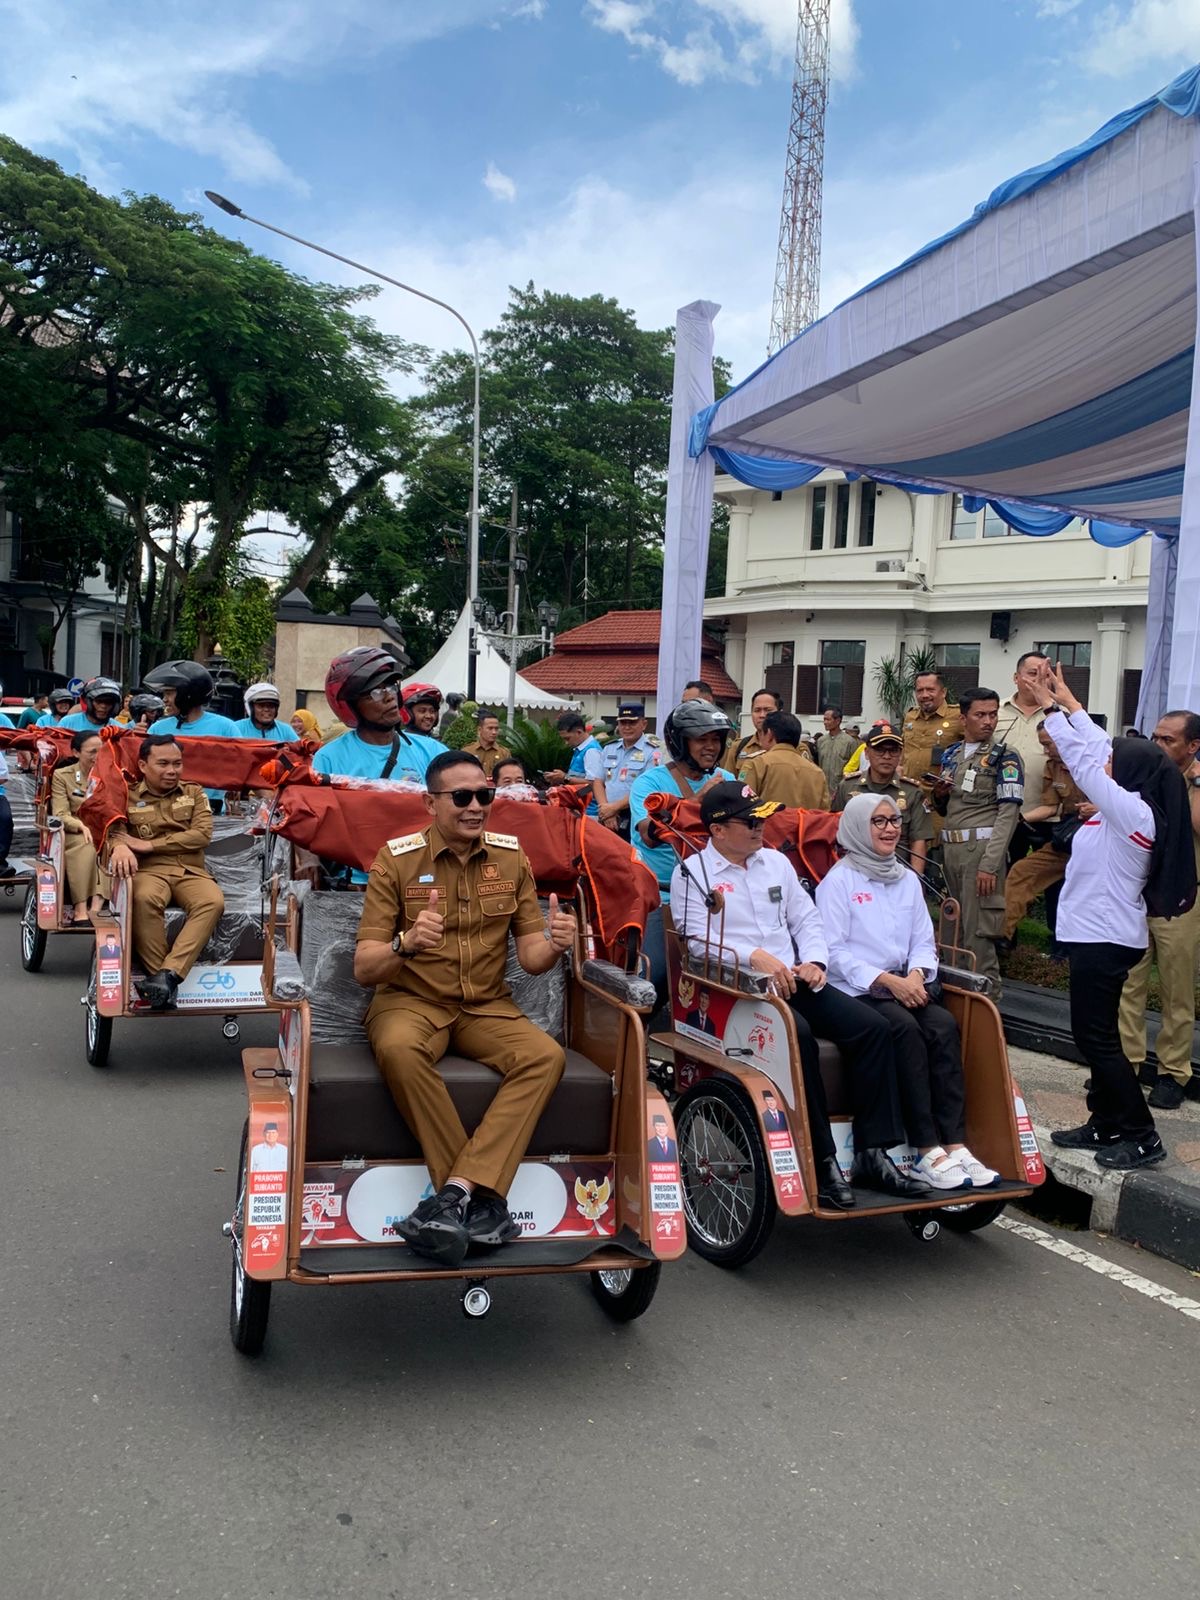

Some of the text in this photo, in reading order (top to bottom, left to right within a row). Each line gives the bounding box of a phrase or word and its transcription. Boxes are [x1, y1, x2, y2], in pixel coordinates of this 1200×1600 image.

[480, 883, 513, 893] WALIKOTA
[652, 1164, 676, 1172] PRABOWO
[254, 1174, 283, 1182] PRABOWO
[254, 1183, 283, 1191] SUBIANTO
[253, 1196, 282, 1204] PRESIDEN
[328, 1197, 335, 1207] 8
[253, 1205, 281, 1213] REPUBLIK
[252, 1215, 282, 1223] INDONESIA
